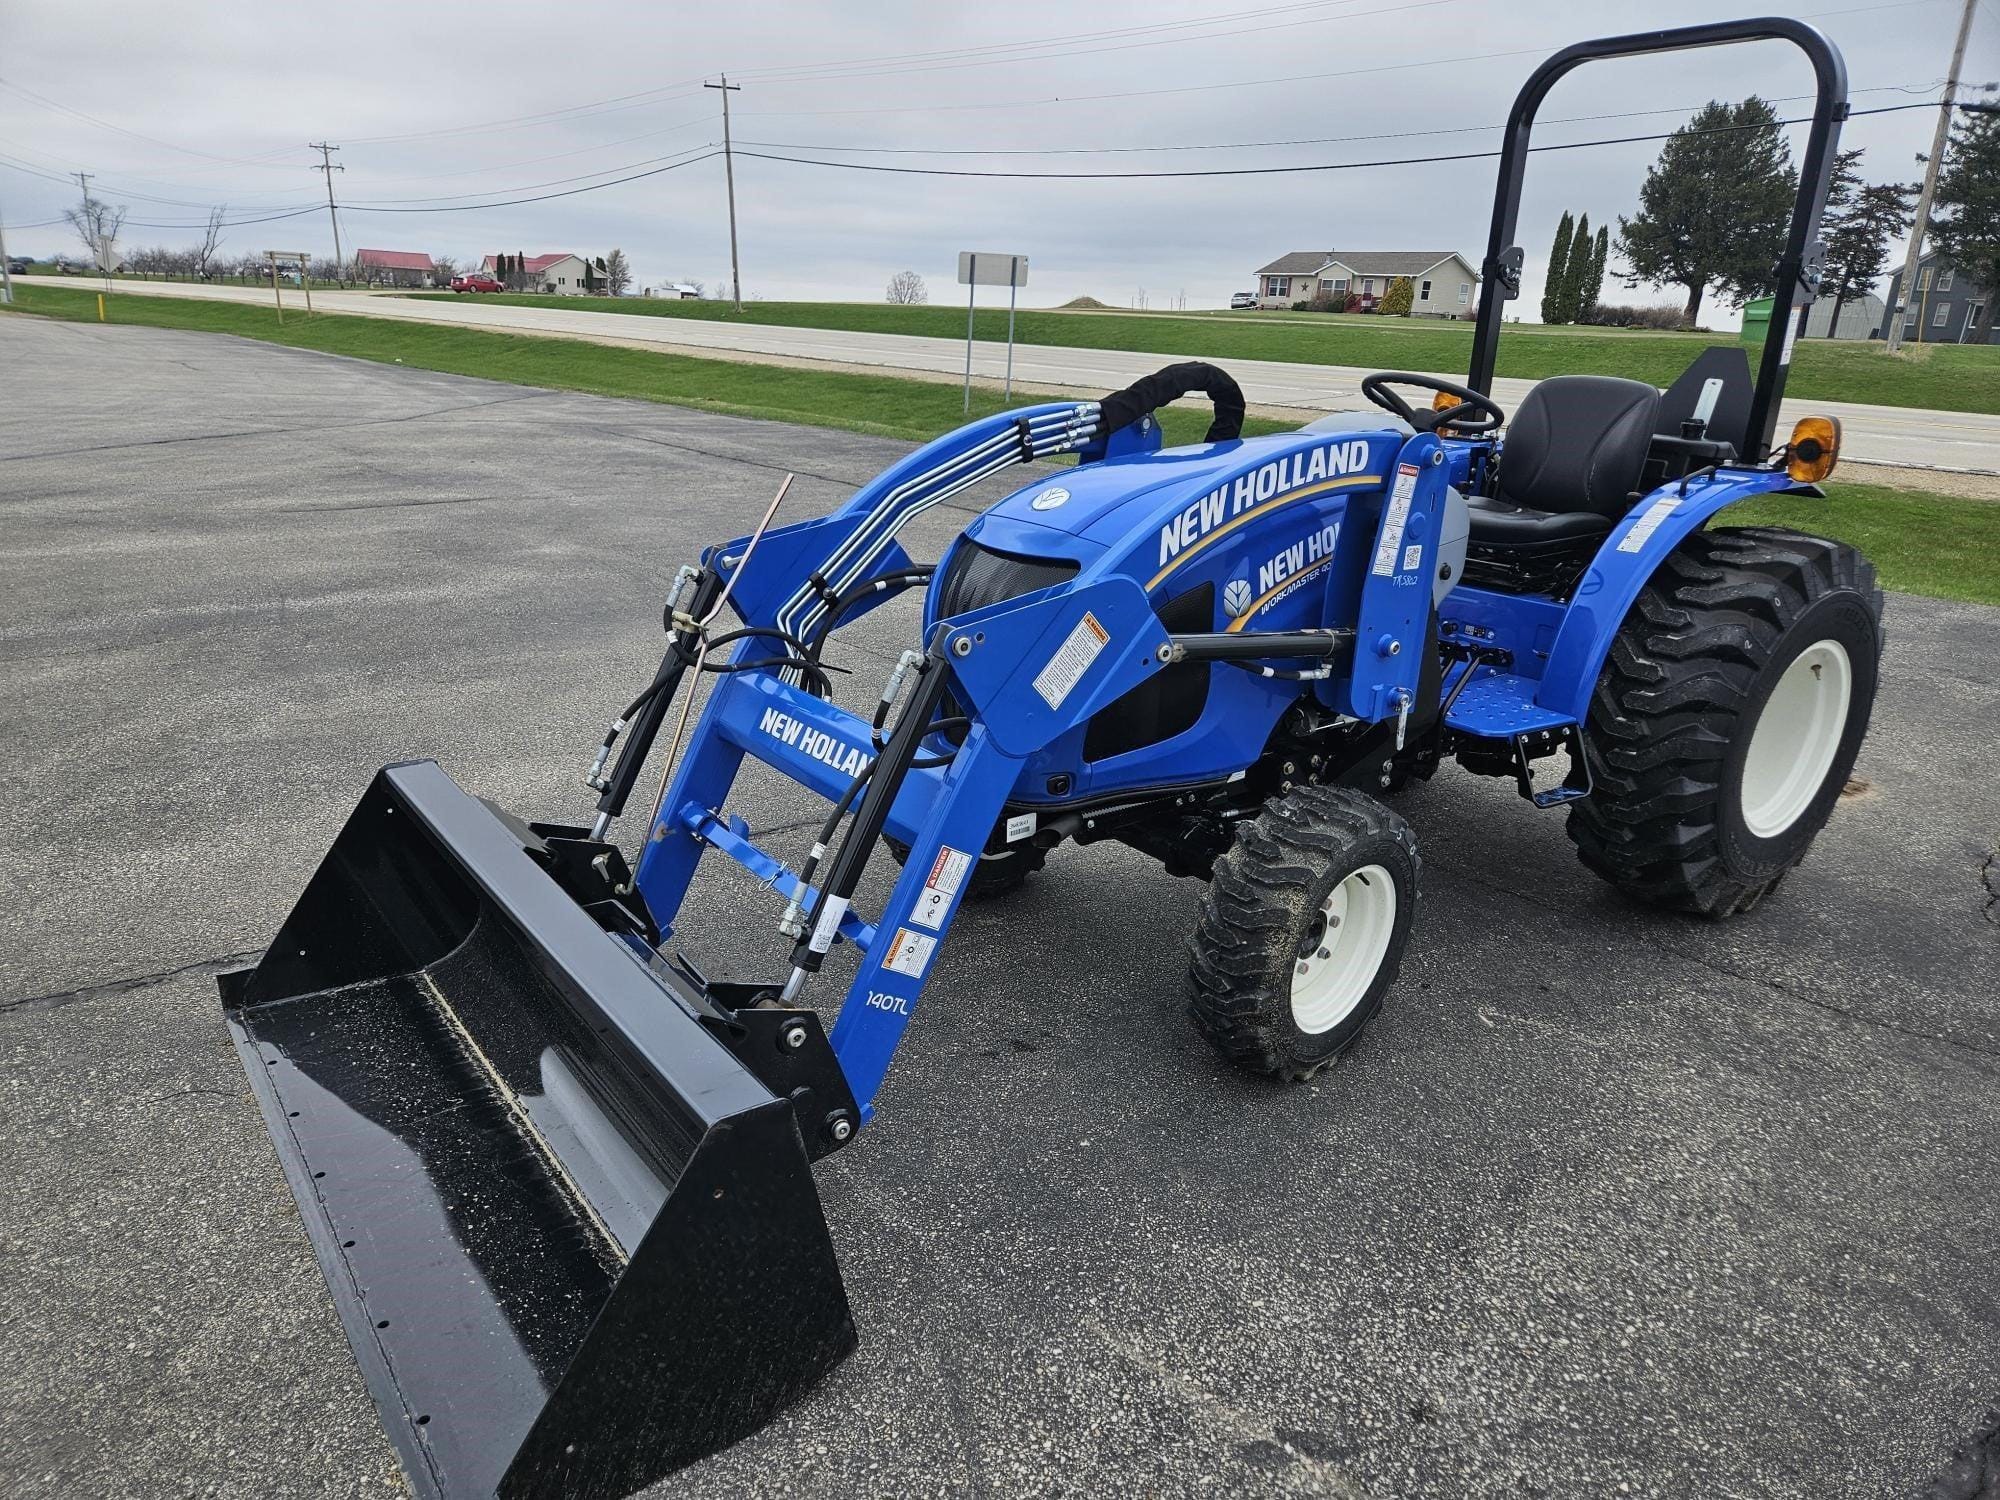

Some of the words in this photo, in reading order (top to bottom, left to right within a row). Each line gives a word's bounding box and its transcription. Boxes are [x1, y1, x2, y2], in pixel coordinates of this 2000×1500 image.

[1159, 484, 1229, 567] NEW
[1232, 440, 1369, 516] HOLLAND
[1259, 540, 1304, 595] NEW
[1261, 568, 1320, 615] WORKMASTER
[759, 706, 804, 746] NEW
[798, 726, 878, 785] HOLLAN
[932, 849, 949, 879] DANGER
[866, 990, 908, 1016] 140TL
